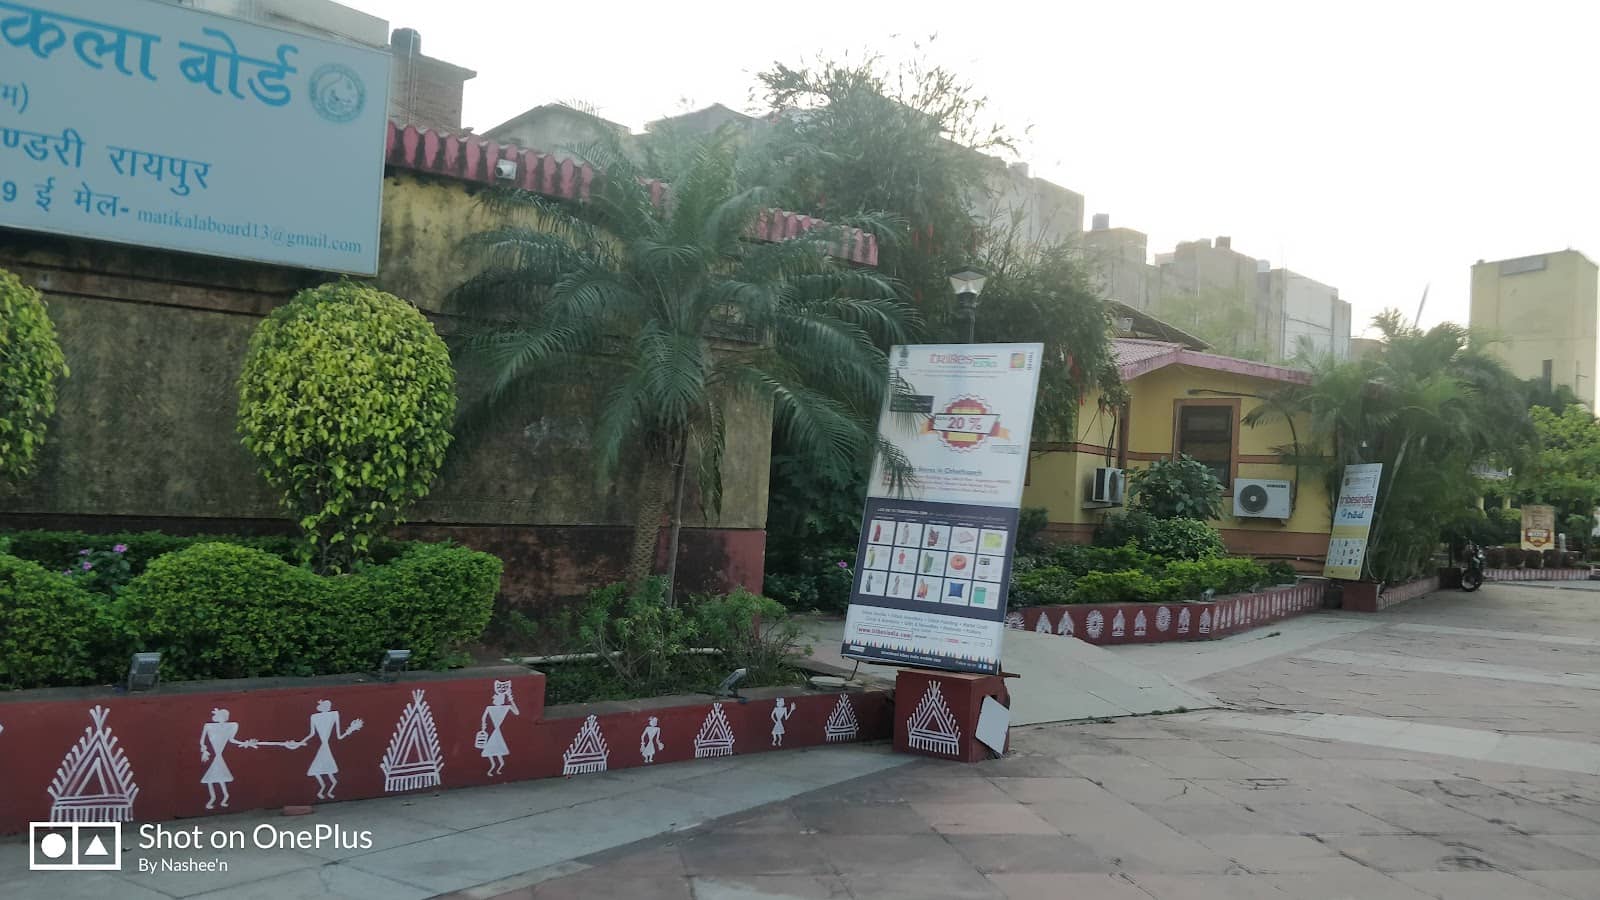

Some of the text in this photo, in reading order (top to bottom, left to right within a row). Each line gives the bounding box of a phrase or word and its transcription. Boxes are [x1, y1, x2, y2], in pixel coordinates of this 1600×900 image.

[179, 27, 299, 107] बोर्ड
[34, 176, 55, 212] ई
[105, 145, 212, 197] रायपुर
[137, 208, 362, 254] matikalaboard13@gmail.com
[947, 416, 965, 430] 20
